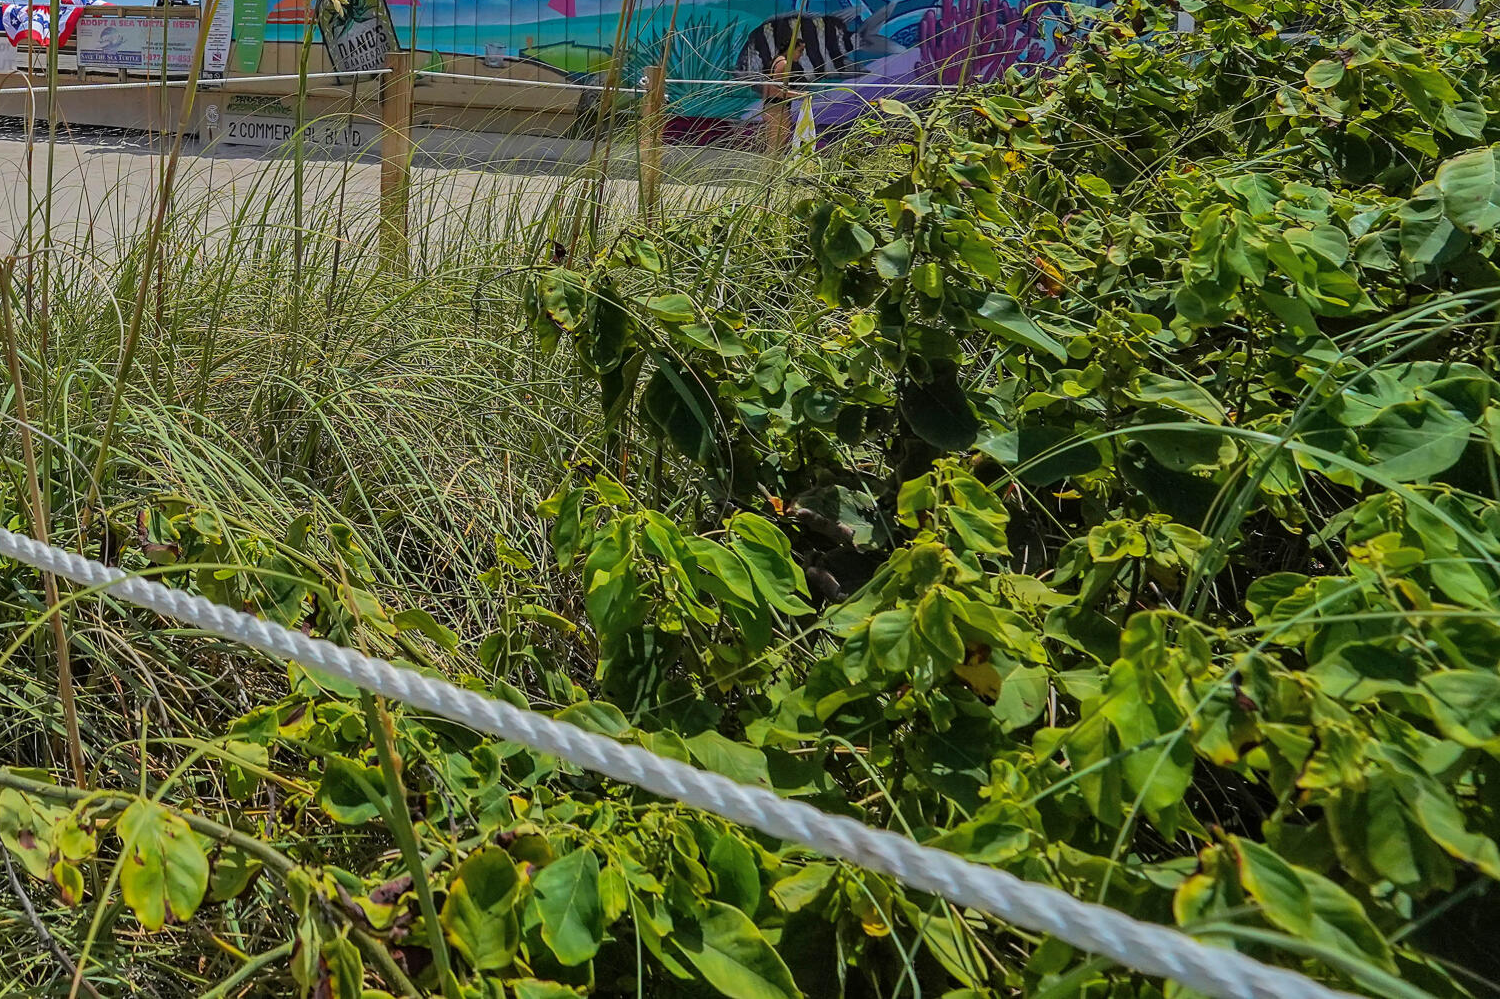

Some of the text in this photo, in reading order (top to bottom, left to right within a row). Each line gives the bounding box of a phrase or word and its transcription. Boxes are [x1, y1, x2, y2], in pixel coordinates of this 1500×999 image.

[80, 19, 108, 27] ADOPT
[110, 19, 116, 27] A
[119, 19, 135, 27] SEA
[173, 21, 197, 29] NEST
[228, 121, 237, 138] 2
